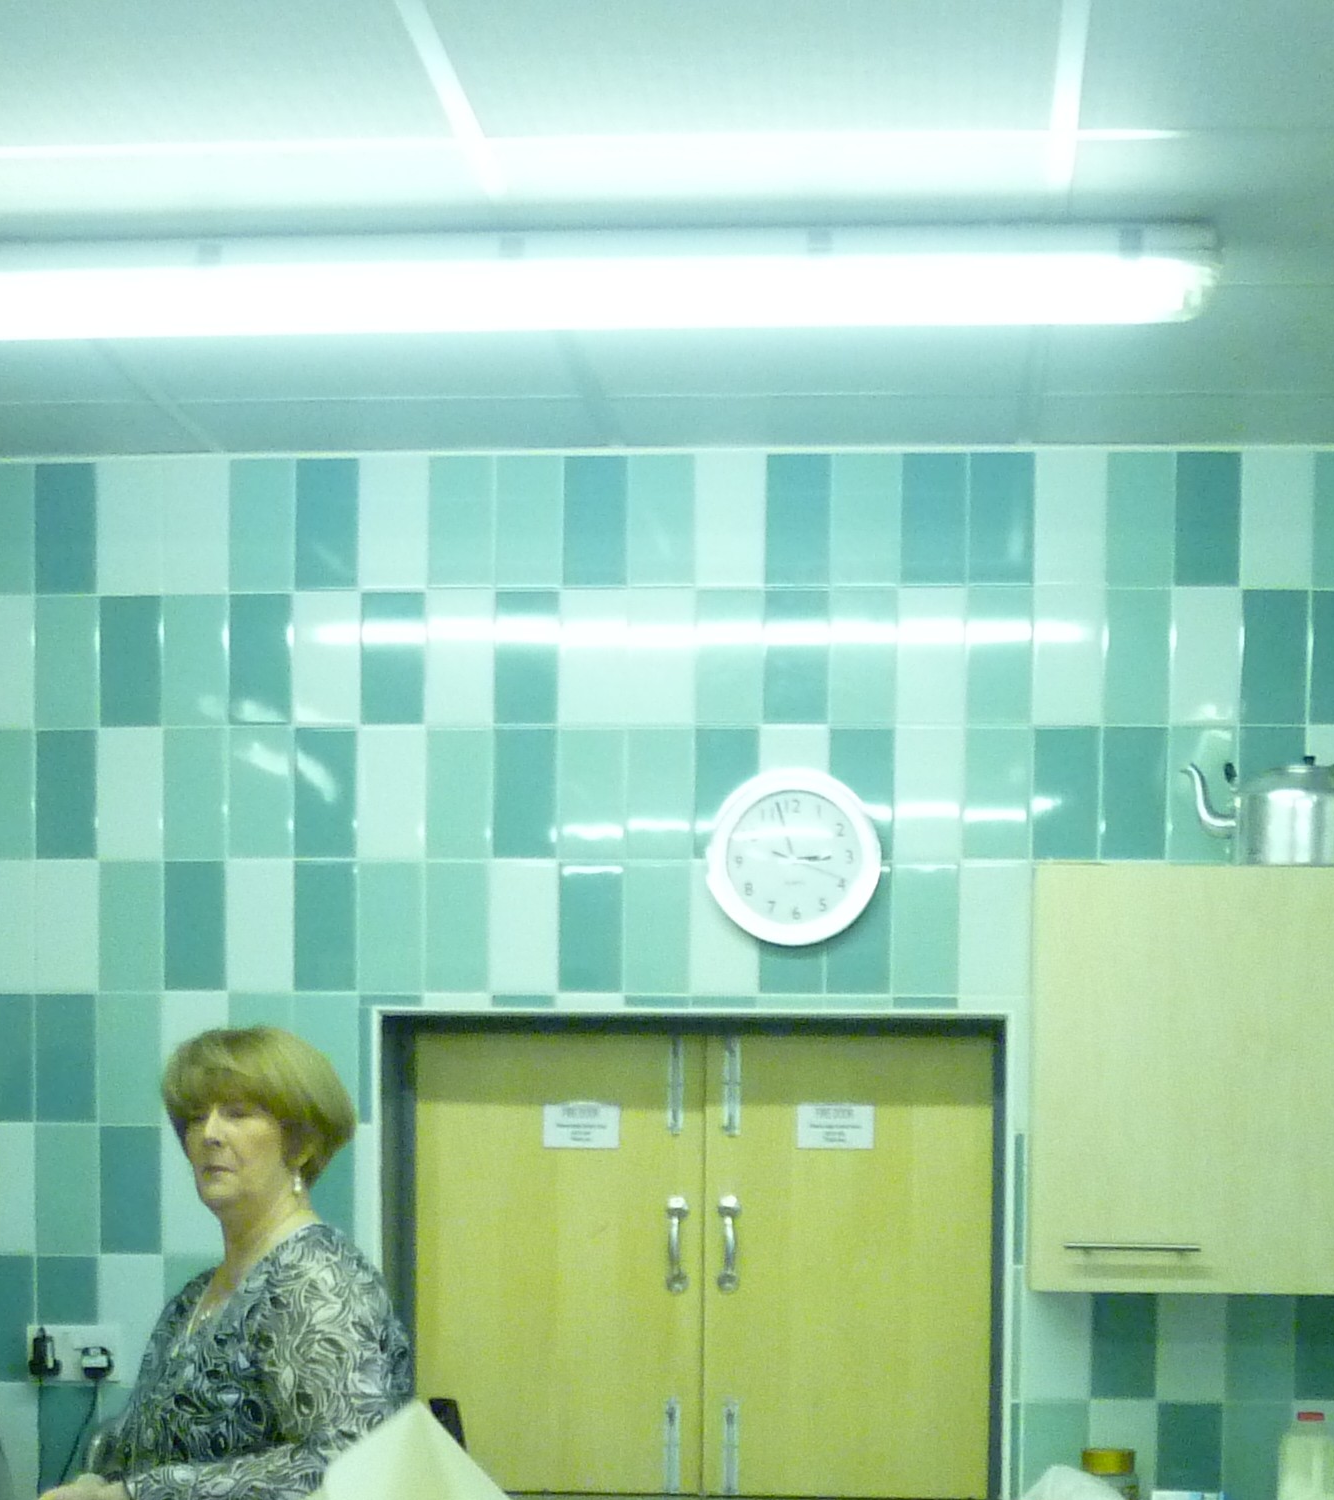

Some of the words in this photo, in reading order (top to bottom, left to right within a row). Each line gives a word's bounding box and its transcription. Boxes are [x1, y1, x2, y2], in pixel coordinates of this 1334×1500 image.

[784, 799, 801, 813] 12
[836, 822, 845, 837] 2
[735, 854, 743, 868] 9
[846, 849, 854, 864] 3
[744, 881, 753, 896] 8
[836, 877, 846, 891] 4
[767, 900, 776, 913] 7
[819, 898, 828, 912] 5
[792, 905, 802, 920] 6
